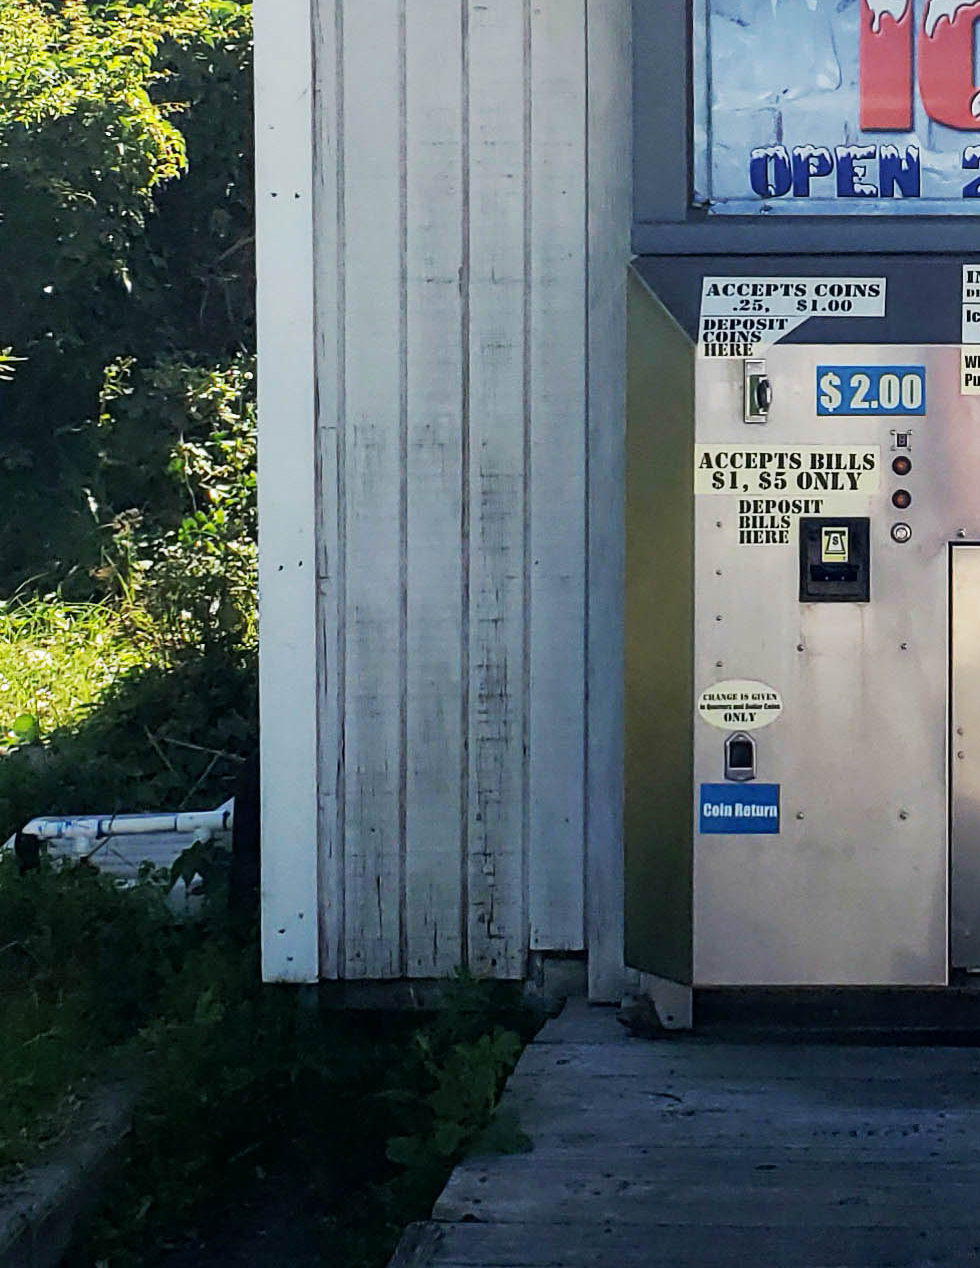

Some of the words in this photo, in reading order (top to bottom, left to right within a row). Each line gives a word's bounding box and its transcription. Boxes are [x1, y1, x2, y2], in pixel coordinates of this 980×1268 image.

[749, 145, 921, 198] OPEN
[706, 284, 807, 297] ACCEPTS
[814, 284, 881, 298] COINS
[733, 300, 770, 313] .25,
[703, 319, 788, 331] DEPOSIT
[703, 331, 762, 344] COINS
[703, 344, 754, 358] HERE
[699, 452, 802, 470] ACCEPTS
[810, 453, 876, 471] BILLS
[712, 471, 749, 493] $1,
[758, 471, 787, 490] $5
[796, 471, 862, 491] ONLY
[738, 499, 823, 514] DEPOSIT
[738, 515, 791, 529] BILLS
[738, 530, 789, 544] HERE
[723, 712, 756, 722] ONLY
[703, 803, 733, 817] Coin
[734, 803, 778, 817] Return
